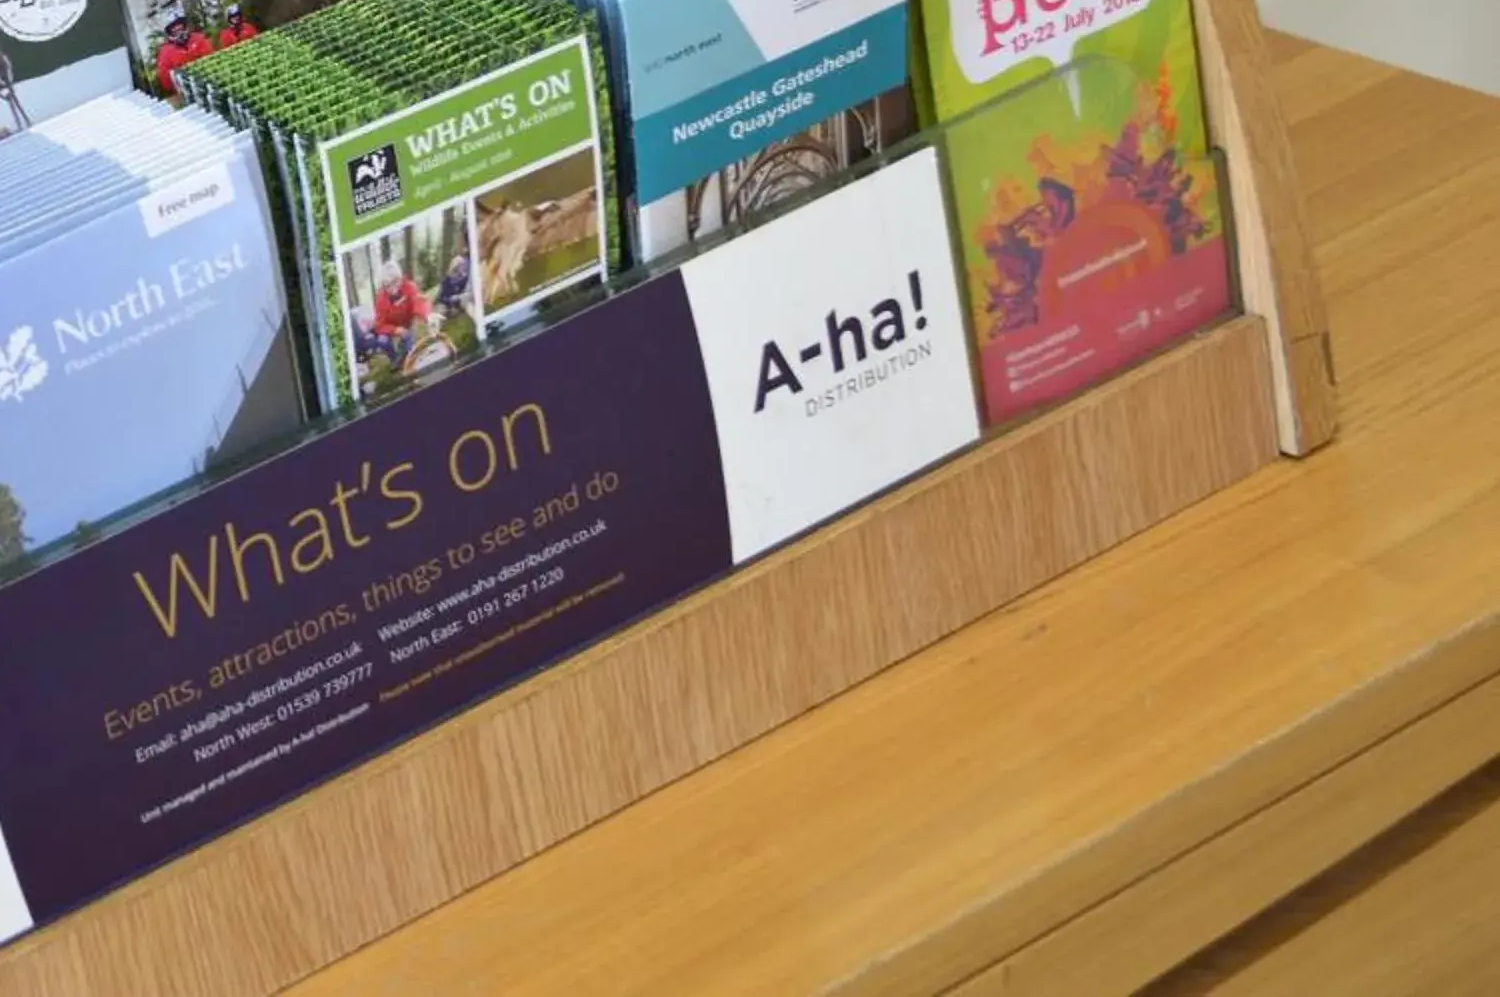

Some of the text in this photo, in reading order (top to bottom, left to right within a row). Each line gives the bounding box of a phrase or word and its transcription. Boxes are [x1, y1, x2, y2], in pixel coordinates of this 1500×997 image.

[1009, 22, 1056, 55] 13-22
[1063, 4, 1095, 34] July
[404, 68, 573, 159] WHAT'S ON
[671, 39, 869, 146] Newcastle Gateshead
[728, 89, 815, 141] Quayside
[157, 181, 220, 220] Free map
[52, 275, 167, 355] North
[168, 242, 249, 300] East
[752, 268, 928, 415] A-ha!
[803, 340, 934, 419] DISTRIBUTION
[131, 400, 553, 640] What's on
[103, 678, 203, 741] Events,
[208, 600, 358, 689] attractions,
[361, 556, 444, 613] things
[446, 542, 476, 570] to
[479, 516, 528, 554] see
[531, 482, 580, 530] and
[585, 470, 620, 501] do
[134, 732, 179, 764] Email:
[179, 641, 364, 743] aha@aha-distribution.co.uk
[376, 605, 436, 643] Website:
[436, 517, 608, 615] www.aha-distribution.co.uk
[389, 635, 431, 665] North
[430, 620, 464, 645] East:
[467, 597, 501, 626] 0191
[502, 584, 530, 609] 267
[529, 566, 566, 595] 1220
[192, 732, 236, 764] North
[235, 712, 277, 741] West:
[276, 690, 322, 723] 01539
[321, 661, 375, 699] 739777
